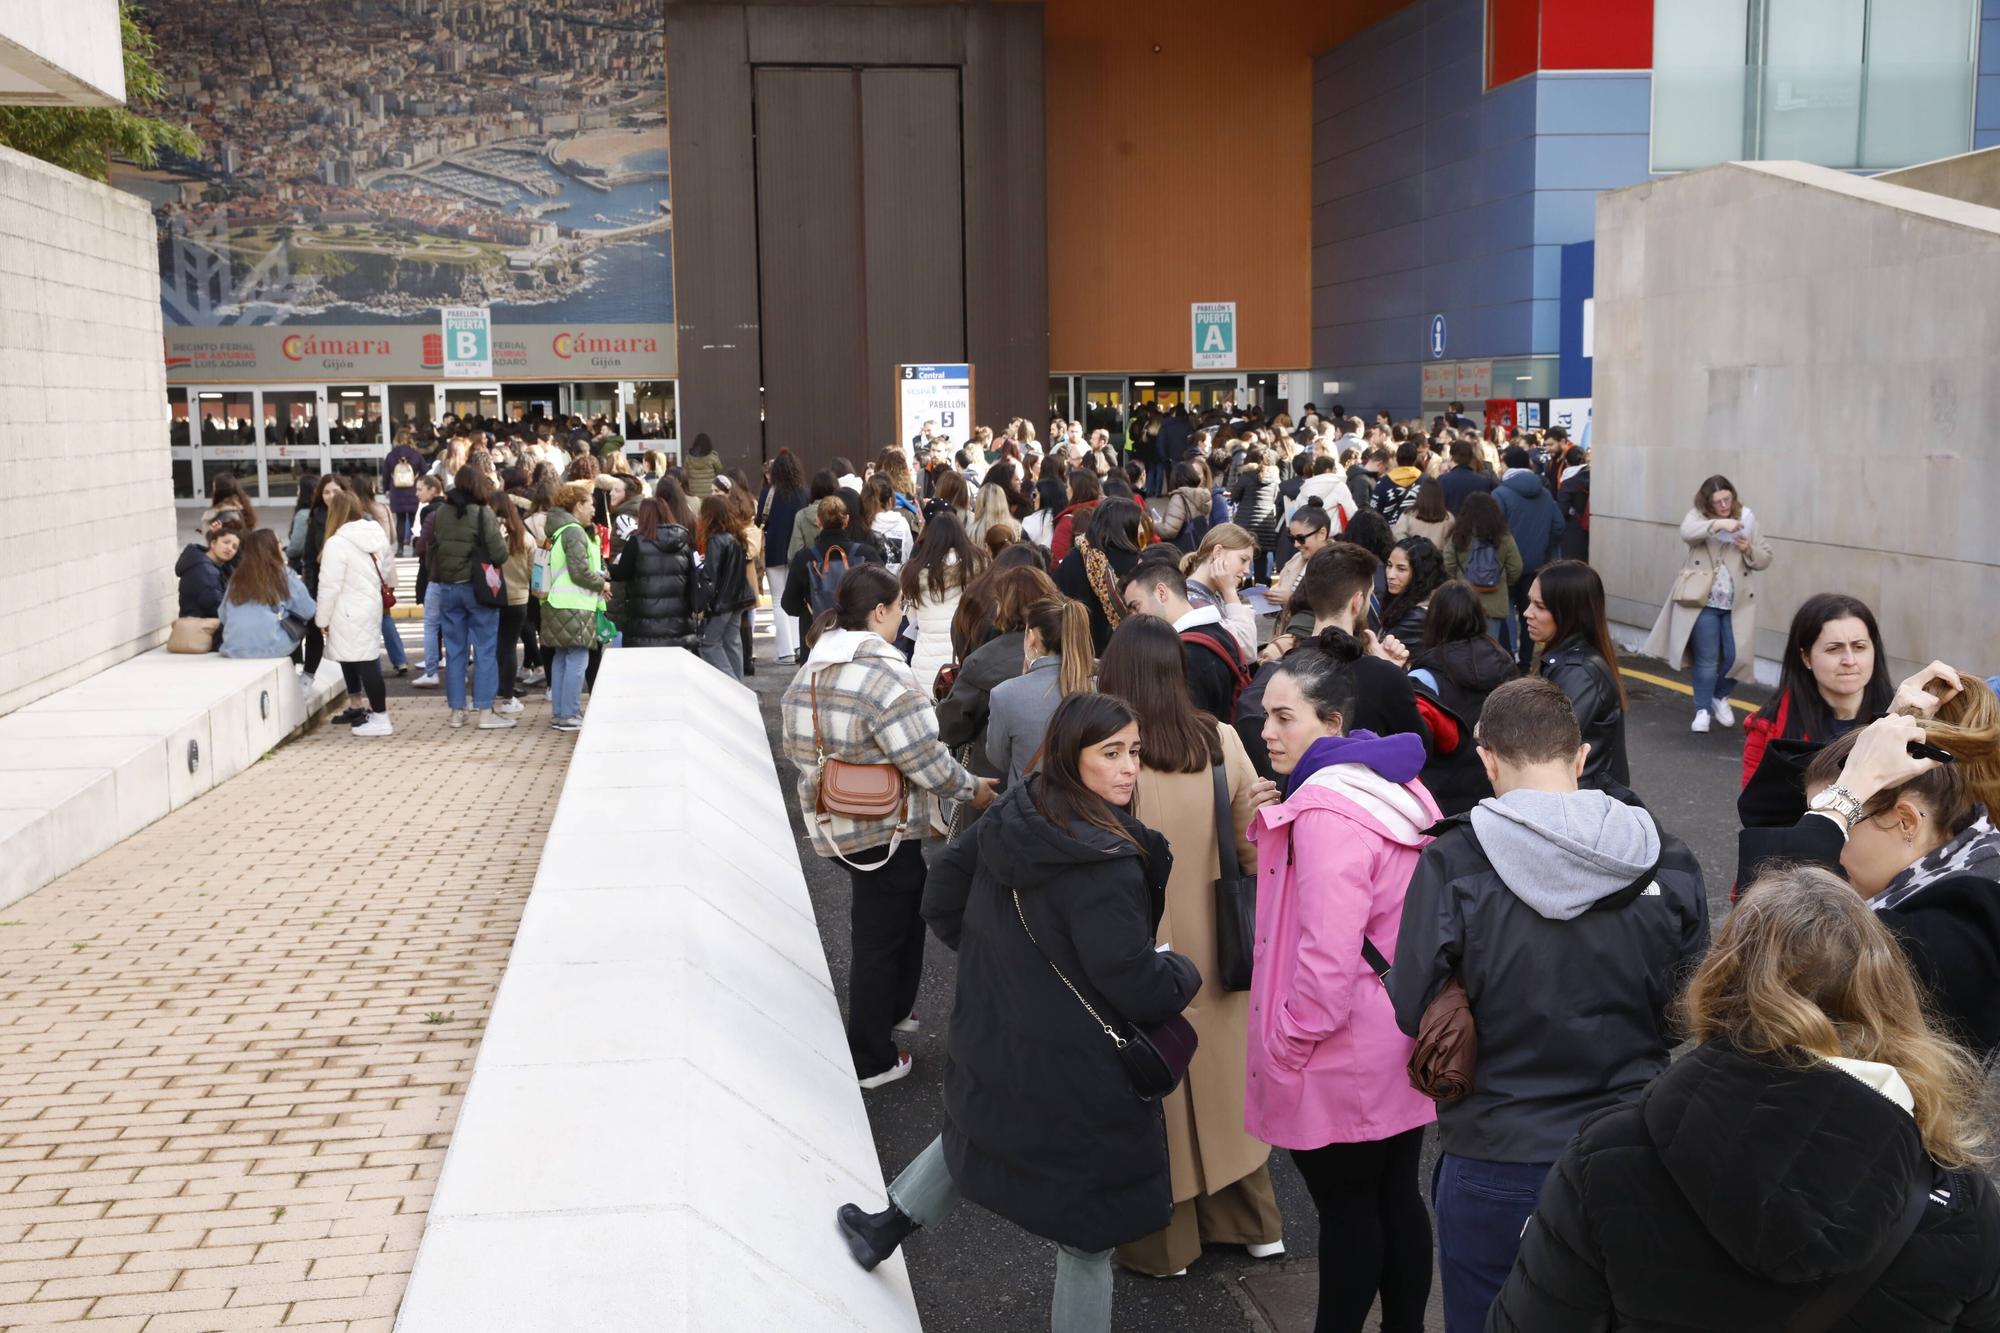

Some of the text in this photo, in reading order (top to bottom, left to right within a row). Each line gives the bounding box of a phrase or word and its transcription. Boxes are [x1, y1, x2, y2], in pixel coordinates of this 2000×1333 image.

[1197, 313, 1230, 324] PUERTA
[448, 319, 484, 330] PUERTA
[1203, 325, 1226, 352] A
[173, 343, 256, 351] RECINTO FERIAL
[282, 334, 391, 361] Cámara
[457, 331, 478, 359] B
[493, 341, 528, 349] FERIAL
[552, 332, 657, 359] Cámara
[194, 352, 256, 360] DE ASTURIAS
[194, 360, 256, 368] LUIS ADARO
[323, 359, 354, 370] Gijón
[492, 358, 528, 366] ADARO
[591, 357, 621, 368] Gijón
[906, 368, 913, 378] 5
[919, 371, 945, 379] Central
[929, 400, 966, 408] PABELLÓN
